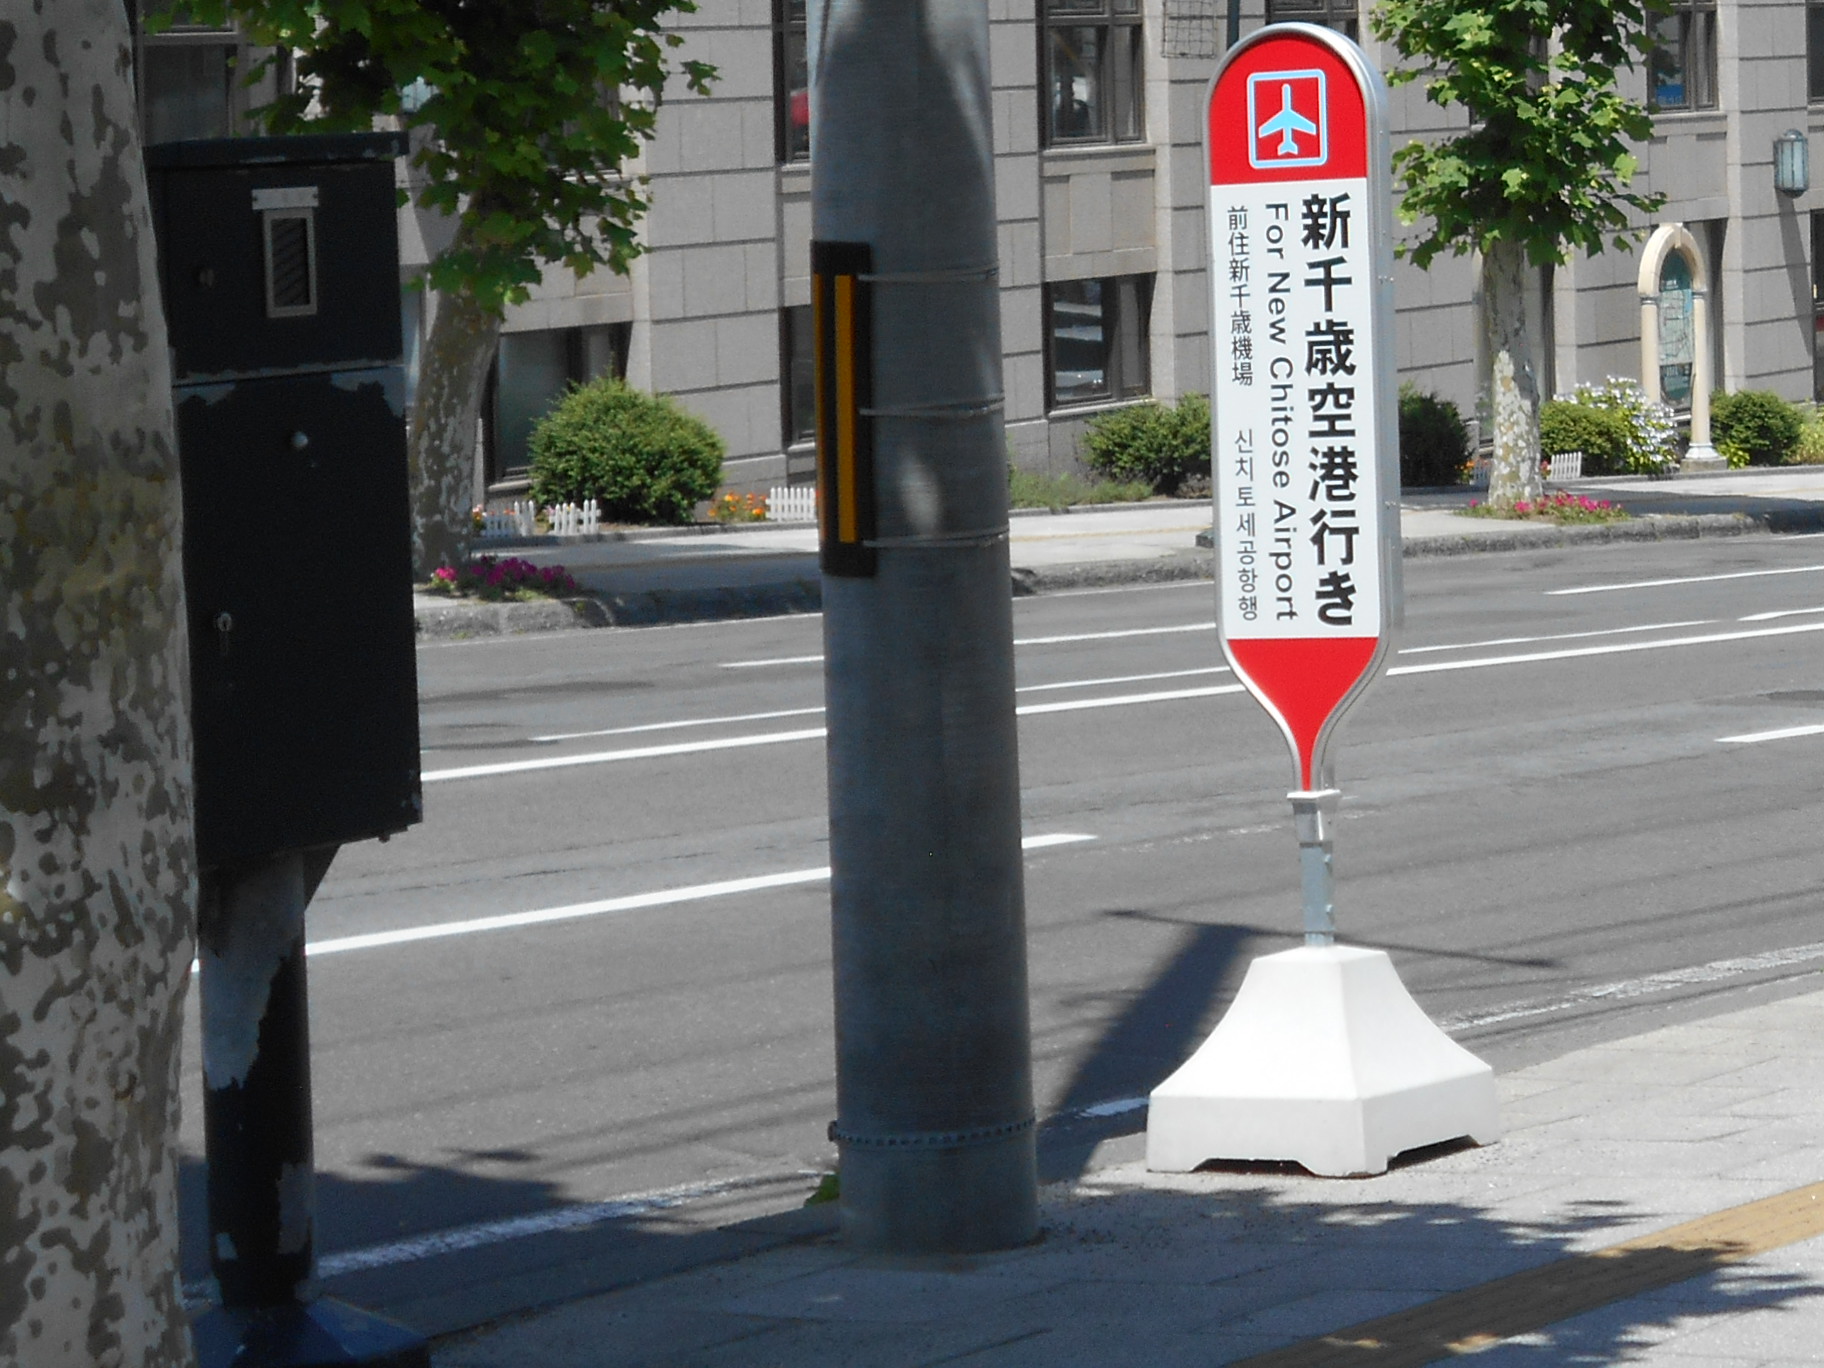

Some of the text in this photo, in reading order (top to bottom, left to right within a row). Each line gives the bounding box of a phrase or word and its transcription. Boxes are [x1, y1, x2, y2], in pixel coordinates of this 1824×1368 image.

[1234, 428, 1259, 622] 신치토세공항행
[1265, 202, 1299, 621] For New Chitose Airport
[1301, 192, 1360, 627] 新千歳空港行き
